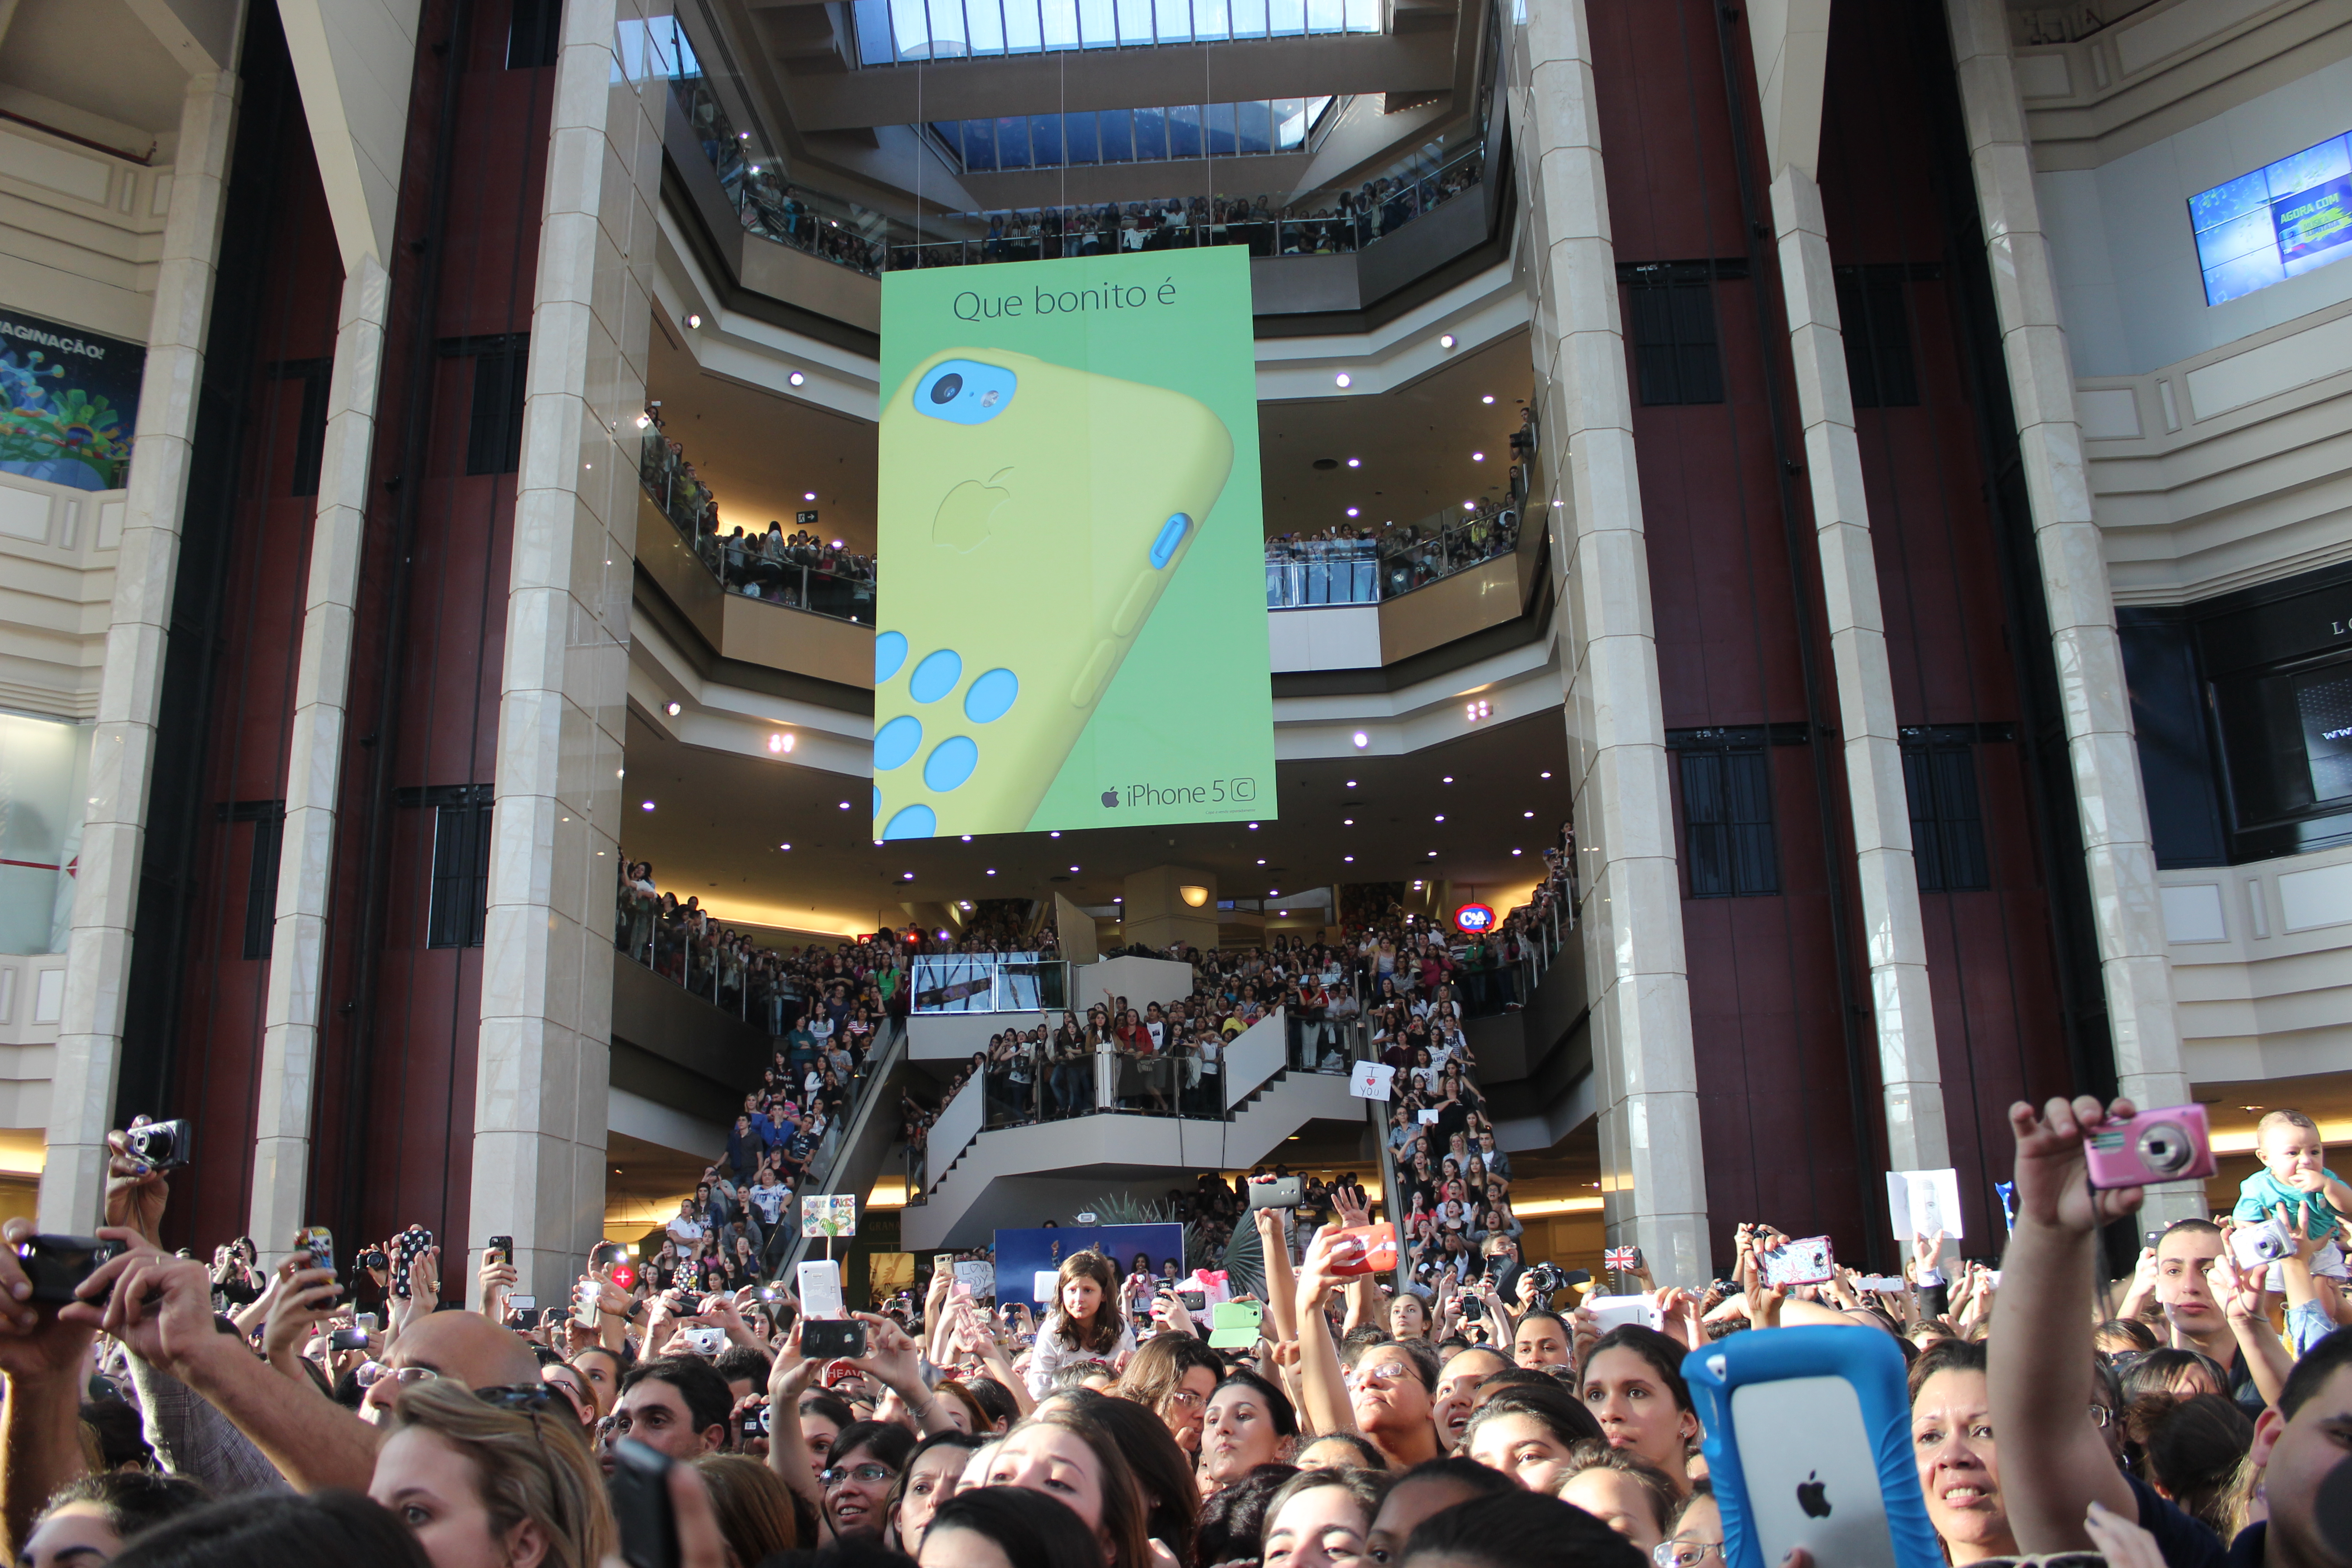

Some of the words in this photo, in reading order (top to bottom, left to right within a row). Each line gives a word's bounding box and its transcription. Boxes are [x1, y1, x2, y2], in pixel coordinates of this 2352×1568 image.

[2280, 202, 2315, 225] AGORA
[2315, 192, 2341, 210] COM
[953, 291, 1023, 322] Que
[1036, 281, 1147, 315] bonito
[1157, 276, 1176, 305] é
[0, 320, 105, 360] AGINAÇÃO!
[1127, 783, 1205, 807] iPhone
[1359, 1085, 1379, 1097] YOU
[804, 1199, 826, 1209] YOUR
[830, 1197, 854, 1208] CAKES
[803, 1213, 819, 1228] THE
[869, 1221, 901, 1231] GRANA
[828, 1369, 862, 1378] HEAV
